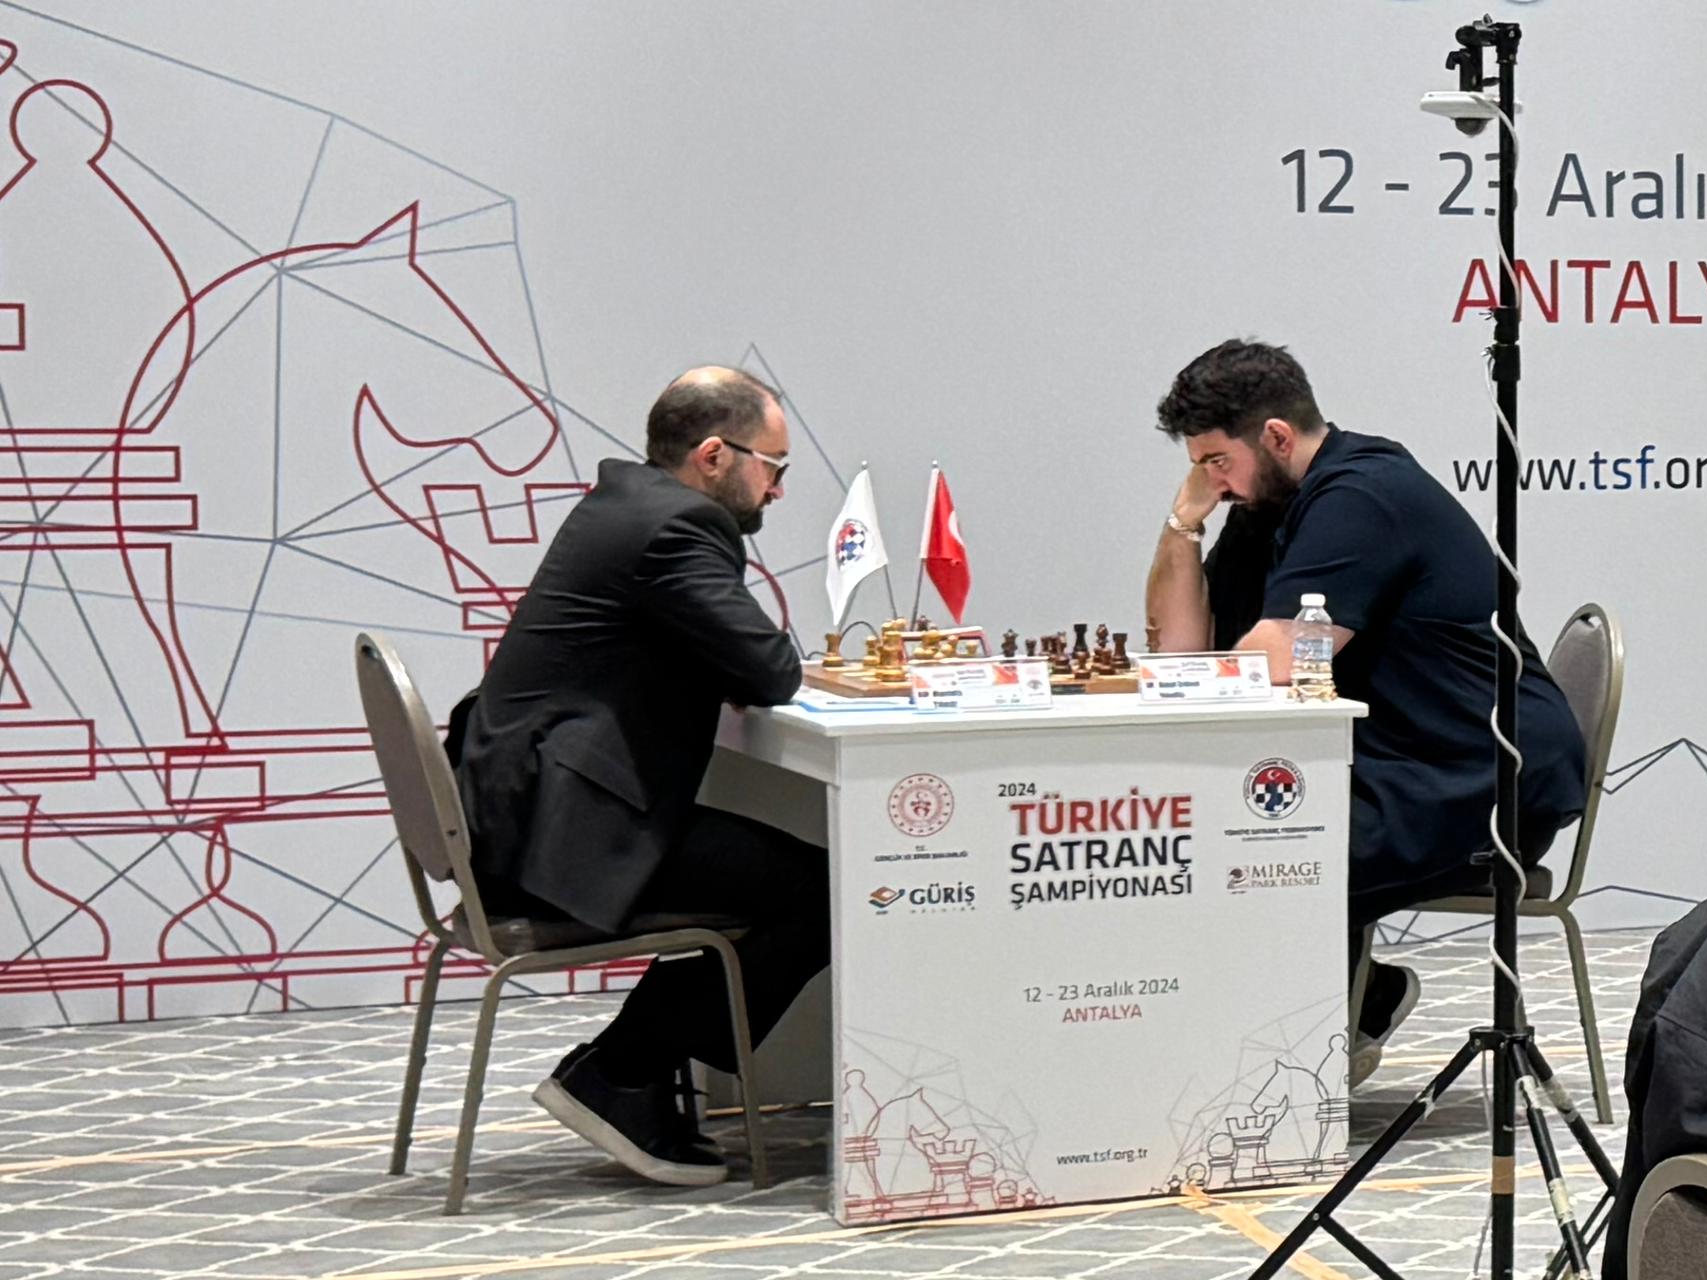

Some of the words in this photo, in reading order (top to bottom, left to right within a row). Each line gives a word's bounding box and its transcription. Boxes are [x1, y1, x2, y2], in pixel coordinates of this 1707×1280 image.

[1281, 149, 1355, 214] 12
[998, 783, 1037, 797] 2024
[1010, 786, 1192, 836] TÜRKİYE
[1010, 834, 1192, 874] SATRANÇ
[1251, 862, 1322, 879] MIRAGE
[909, 881, 976, 907] GÜRİŞ
[1011, 873, 1192, 910] ŞAMPİYONASI
[1024, 987, 1041, 1002] 12
[1058, 985, 1079, 1001] 23
[1084, 981, 1134, 998] Aralık
[1138, 978, 1180, 996] 2024
[1062, 1004, 1143, 1023] ANTALYA
